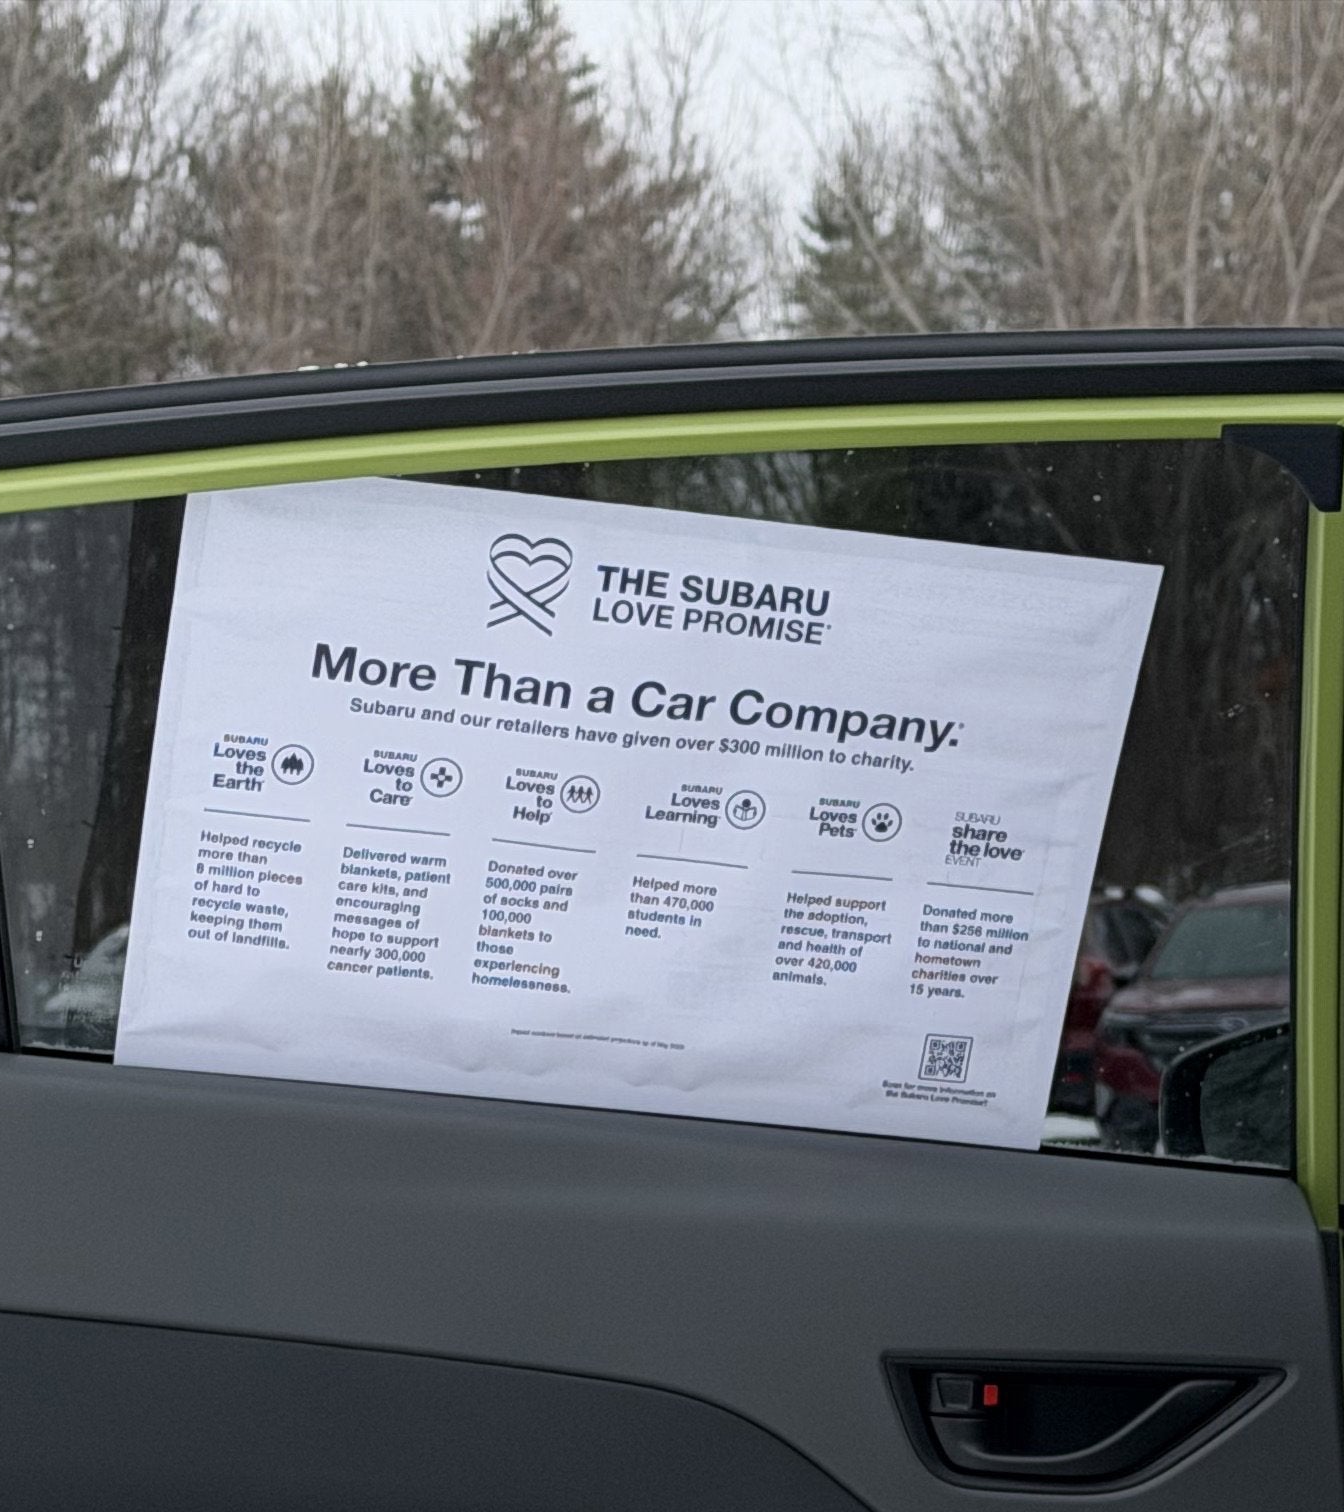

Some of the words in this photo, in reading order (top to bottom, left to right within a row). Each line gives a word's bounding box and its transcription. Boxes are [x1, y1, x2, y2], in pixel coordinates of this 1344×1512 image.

[597, 565, 669, 599] THE
[680, 575, 830, 616] SUBARU
[592, 600, 674, 630] LOVE
[683, 608, 825, 645] PROMISE
[311, 643, 437, 692] More
[454, 658, 572, 709] Than
[587, 685, 615, 714] a
[631, 681, 717, 723] Car
[729, 689, 960, 753] Company.
[224, 734, 268, 746] SUBARU
[350, 697, 417, 724] Subaru
[420, 704, 456, 725] and
[460, 711, 493, 728] our
[496, 715, 571, 740] retailers
[575, 723, 618, 744] have
[622, 729, 671, 752] given
[675, 735, 716, 752] over
[718, 736, 761, 757] $300
[764, 741, 825, 765] million
[828, 749, 847, 766] to
[851, 750, 916, 774] charity.
[213, 742, 266, 761] Loves
[373, 750, 418, 762] SUBARU
[236, 760, 264, 776] the
[363, 758, 415, 777] Loves
[516, 768, 558, 780] SUBARU
[212, 773, 263, 792] Earth
[395, 777, 413, 792] to
[506, 776, 555, 795] Loves
[681, 784, 723, 795] SUBARU
[369, 789, 410, 806] Care
[536, 795, 553, 809] to
[670, 793, 720, 810] Loves
[819, 798, 860, 808] SUBARU
[513, 806, 550, 825] Help
[645, 806, 718, 828] Learning
[809, 807, 857, 824] Loves
[955, 812, 1001, 825] SUBARU
[819, 823, 855, 838] Pets
[952, 824, 1007, 843] share
[200, 829, 248, 847] Helped
[252, 836, 302, 853] recycle
[949, 840, 981, 857] the
[984, 843, 1023, 861] love
[198, 848, 233, 861] more
[238, 851, 268, 864] than
[343, 847, 406, 864] Delivered
[410, 854, 447, 867] warm
[945, 855, 981, 868] EVENT
[208, 866, 254, 880] million
[259, 870, 303, 885] pieces
[340, 863, 401, 881] blankets,
[404, 869, 451, 884] patient
[488, 861, 545, 877] Donated
[547, 869, 578, 881] over
[194, 880, 209, 891] of
[212, 881, 243, 895] hard
[247, 885, 260, 897] to
[338, 880, 367, 892] care
[371, 881, 399, 897] kits,
[403, 886, 428, 898] and
[485, 877, 537, 892] 500,000
[540, 883, 573, 896] pairs
[632, 876, 679, 893] Helped
[683, 883, 717, 896] more
[192, 896, 241, 912] recycle
[246, 903, 289, 918] waste,
[336, 896, 421, 916] encouraging
[483, 893, 498, 905] of
[501, 896, 539, 908] socks
[543, 899, 569, 912] and
[630, 892, 659, 906] than
[663, 896, 714, 913] 470,000
[786, 892, 832, 906] Helped
[835, 897, 886, 911] support
[190, 911, 244, 930] keeping
[248, 918, 282, 932] them
[334, 913, 401, 930] messages
[406, 918, 420, 930] of
[482, 909, 532, 924] 100,000
[627, 908, 685, 925] students
[689, 915, 702, 927] in
[784, 909, 804, 919] the
[808, 911, 868, 927] adoption,
[923, 904, 976, 921] Donated
[980, 911, 1013, 924] more
[188, 928, 210, 940] out
[215, 930, 228, 942] of
[232, 932, 290, 950] landfills.
[332, 927, 366, 942] hope
[370, 931, 383, 943] to
[387, 934, 439, 948] support
[478, 924, 535, 941] blankets
[538, 930, 553, 943] to
[625, 925, 661, 938] need.
[781, 924, 828, 939] rescue,
[832, 928, 892, 944] transport
[920, 921, 948, 934] than
[986, 926, 1029, 941] million
[329, 944, 371, 960] nearly
[374, 948, 426, 963] 300,000
[476, 941, 514, 955] those
[778, 940, 803, 951] and
[806, 941, 846, 955] health
[850, 946, 864, 957] of
[917, 937, 931, 948] to
[934, 938, 985, 953] national
[988, 944, 1013, 955] and
[327, 960, 373, 974] cancer
[376, 964, 434, 980] patients.
[474, 958, 560, 978] experiencing
[775, 956, 804, 967] over
[808, 958, 857, 973] 420,000
[914, 953, 981, 968] hometown
[472, 972, 571, 993] homelessness.
[772, 971, 827, 986] animals.
[911, 969, 966, 983] charities
[969, 973, 999, 985] over
[910, 985, 924, 995] 15
[927, 986, 965, 999] years.
